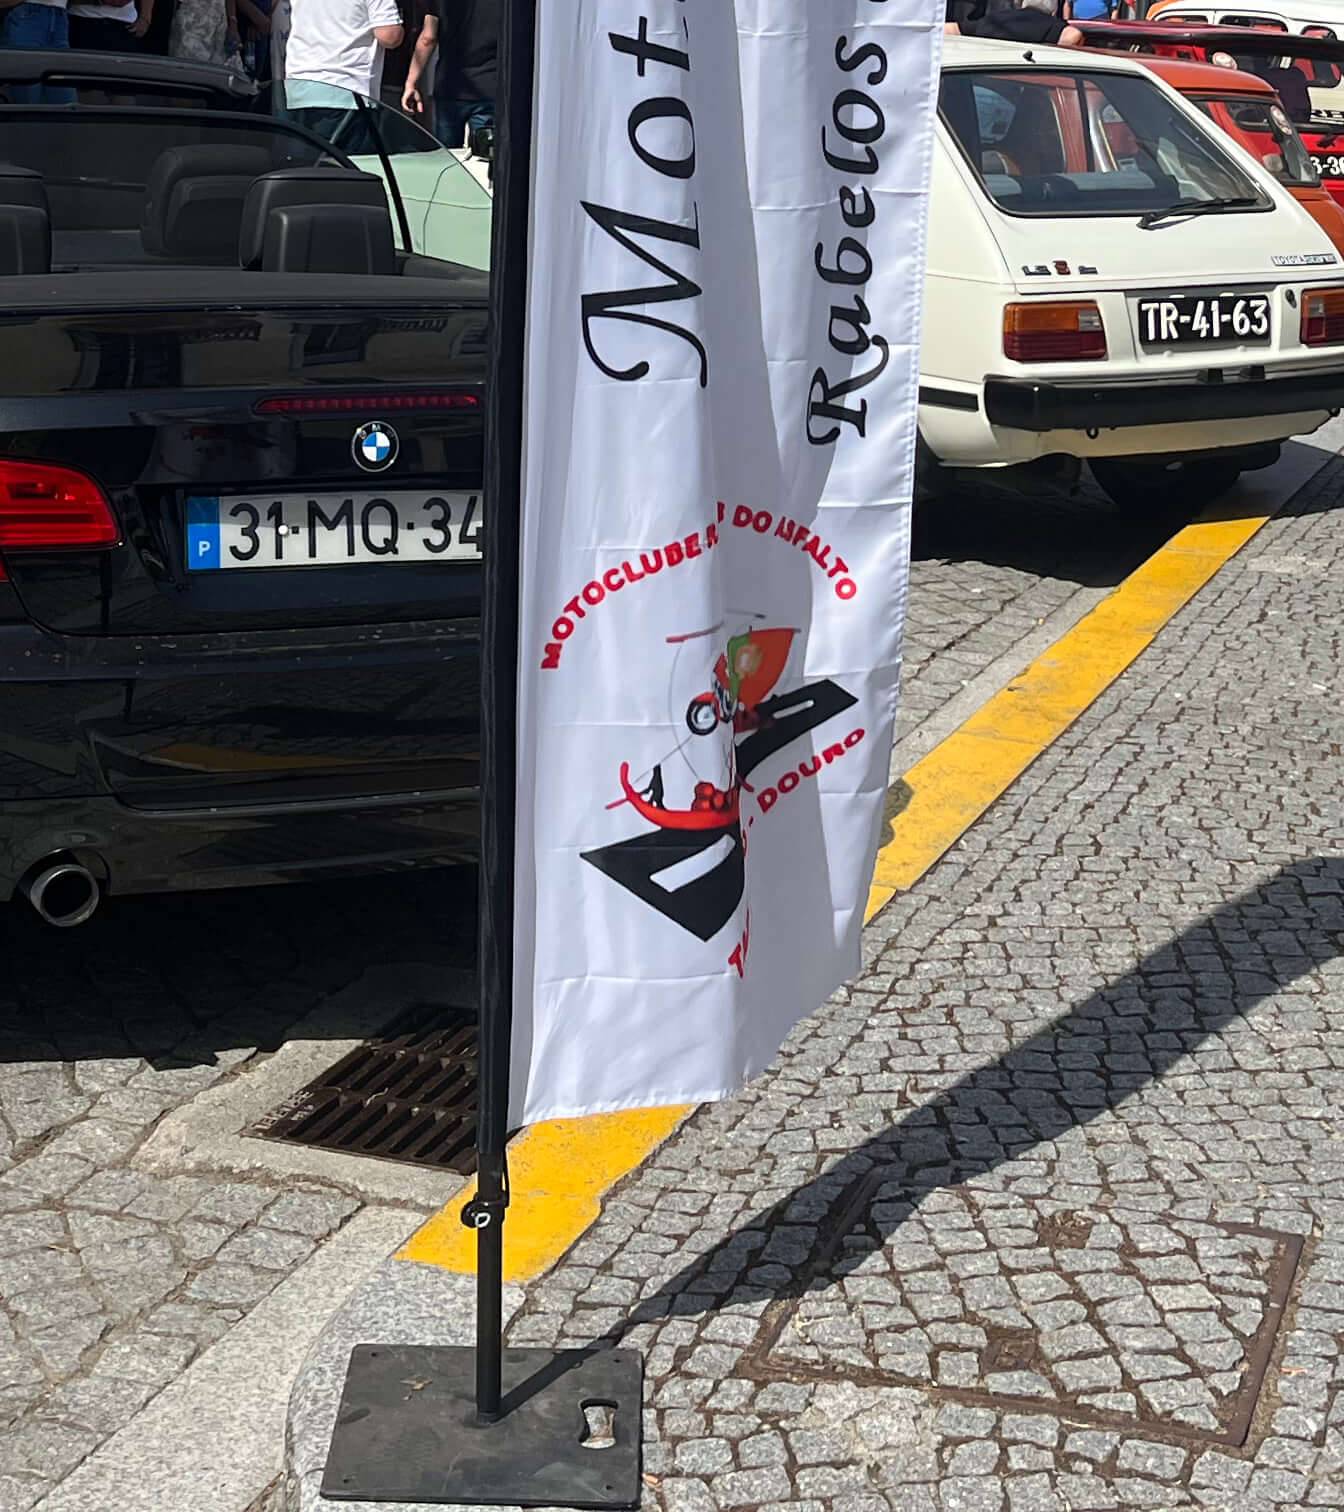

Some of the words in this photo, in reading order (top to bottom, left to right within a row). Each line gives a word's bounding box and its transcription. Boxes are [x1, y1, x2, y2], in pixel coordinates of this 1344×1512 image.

[806, 34, 890, 446] Rabelos
[1141, 299, 1269, 341] TR-41-63
[198, 540, 211, 557] P
[540, 529, 703, 670] MOTOCLUBE
[732, 504, 773, 535] DO
[756, 727, 865, 814] DOURO
